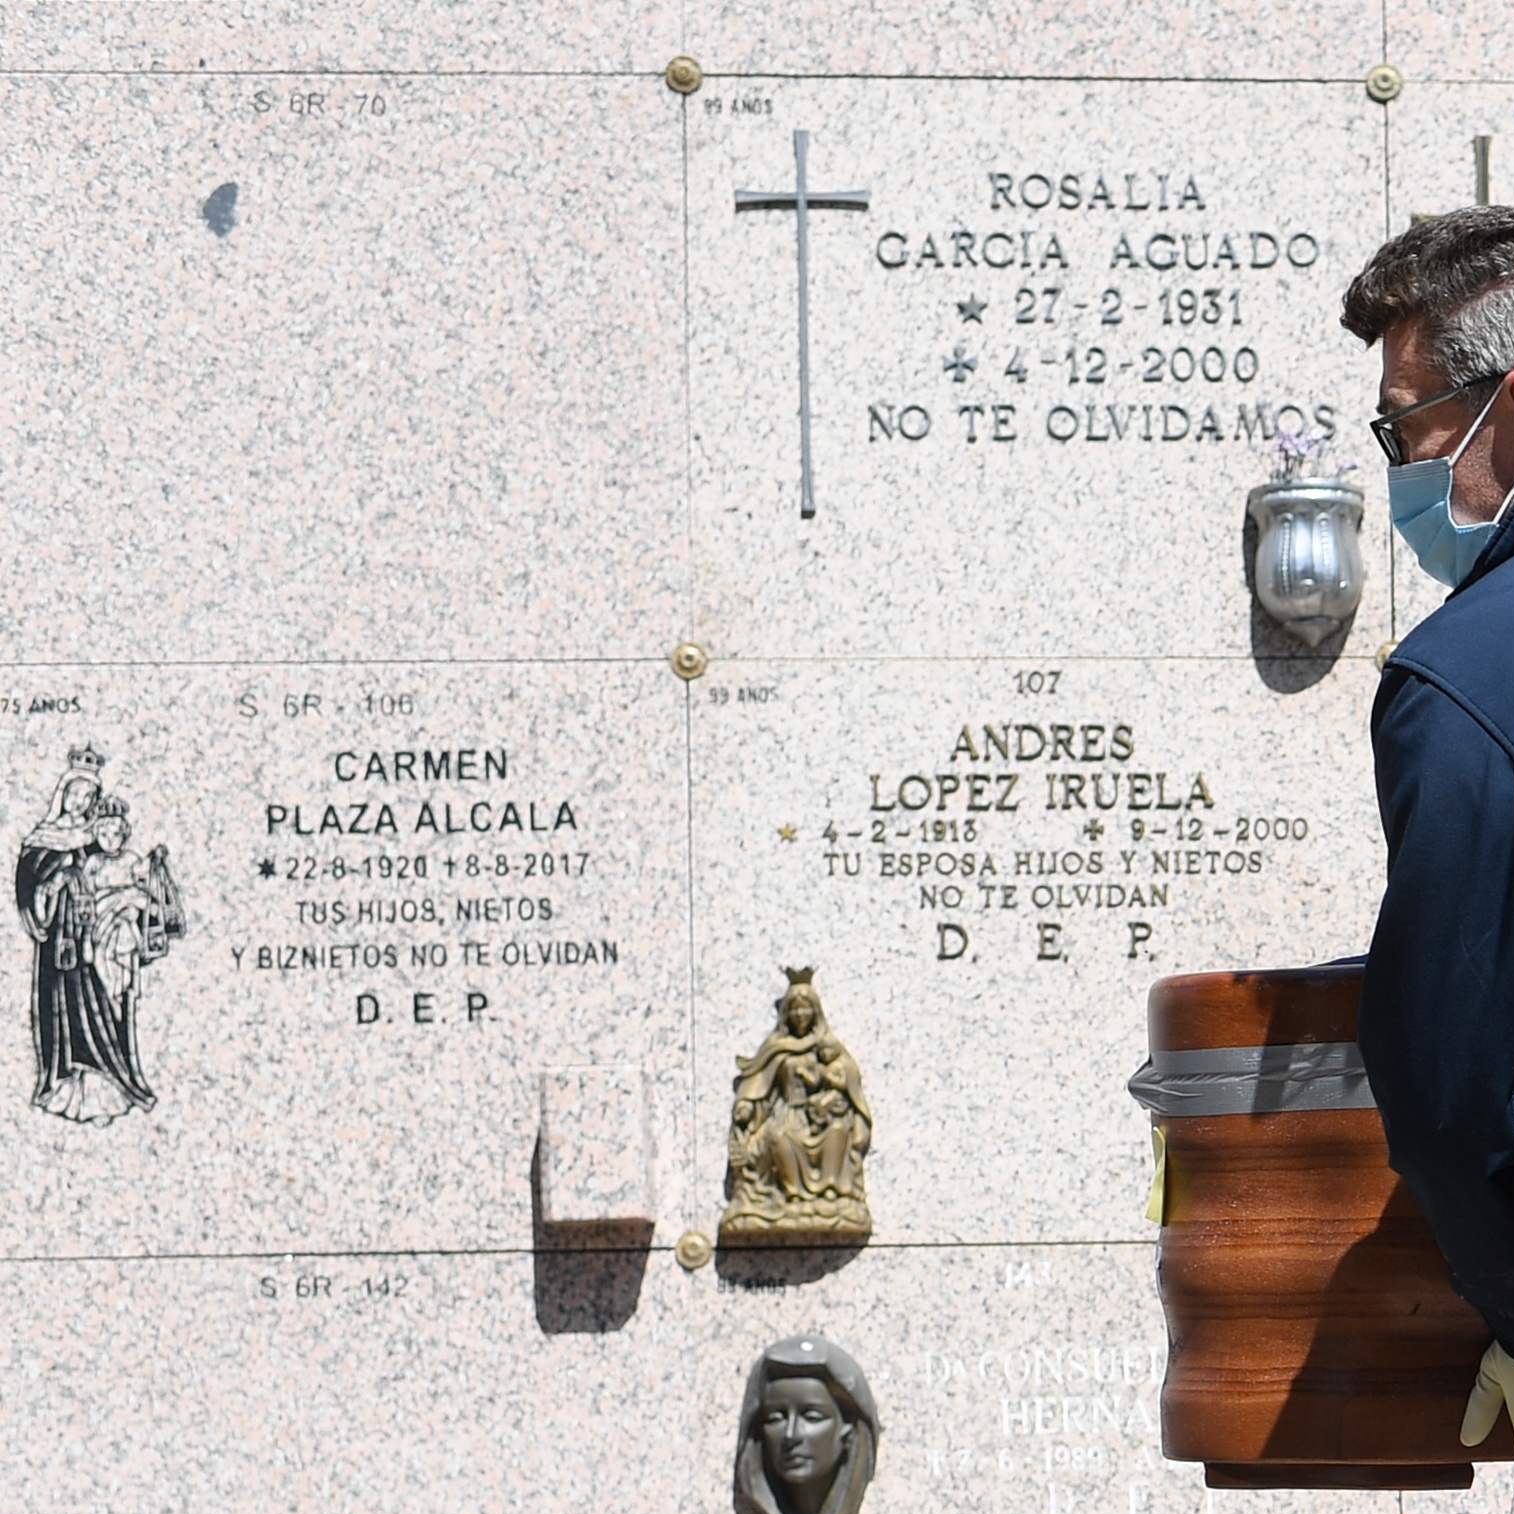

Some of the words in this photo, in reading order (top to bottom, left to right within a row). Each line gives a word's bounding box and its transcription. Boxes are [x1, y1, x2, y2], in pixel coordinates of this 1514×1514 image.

[989, 173, 1207, 211] ROSALIA
[875, 231, 1070, 270] GARCIA
[1109, 231, 1319, 270] AGUADO
[868, 405, 931, 442] NO
[958, 405, 1017, 442] TE
[1046, 404, 1338, 442] OLVIDAMOS
[1015, 671, 1062, 693] 107
[950, 725, 1134, 761] ANDRES
[335, 750, 508, 782] CARMEN
[869, 774, 1019, 811] LOPEZ
[1045, 773, 1214, 811] IRUELA
[267, 803, 398, 835] PLAZA
[415, 801, 578, 833] ALCALA
[823, 852, 861, 876] TU
[879, 852, 997, 877] ESPOSA
[1015, 852, 1104, 875] HIJOS
[1120, 851, 1136, 874] Y
[1151, 851, 1264, 874] NIETOS
[295, 900, 346, 924] TUS
[457, 898, 553, 922] NIETOS
[919, 886, 963, 909] NO
[979, 885, 1019, 909] TE
[1031, 884, 1169, 909] OLVIDAN
[231, 947, 246, 969] Y
[257, 944, 398, 969] BIZNIETOS
[411, 944, 447, 967] NO
[460, 944, 490, 967] TE
[502, 941, 618, 966] OLVIDAN
[1001, 1397, 1156, 1435] HERNA
